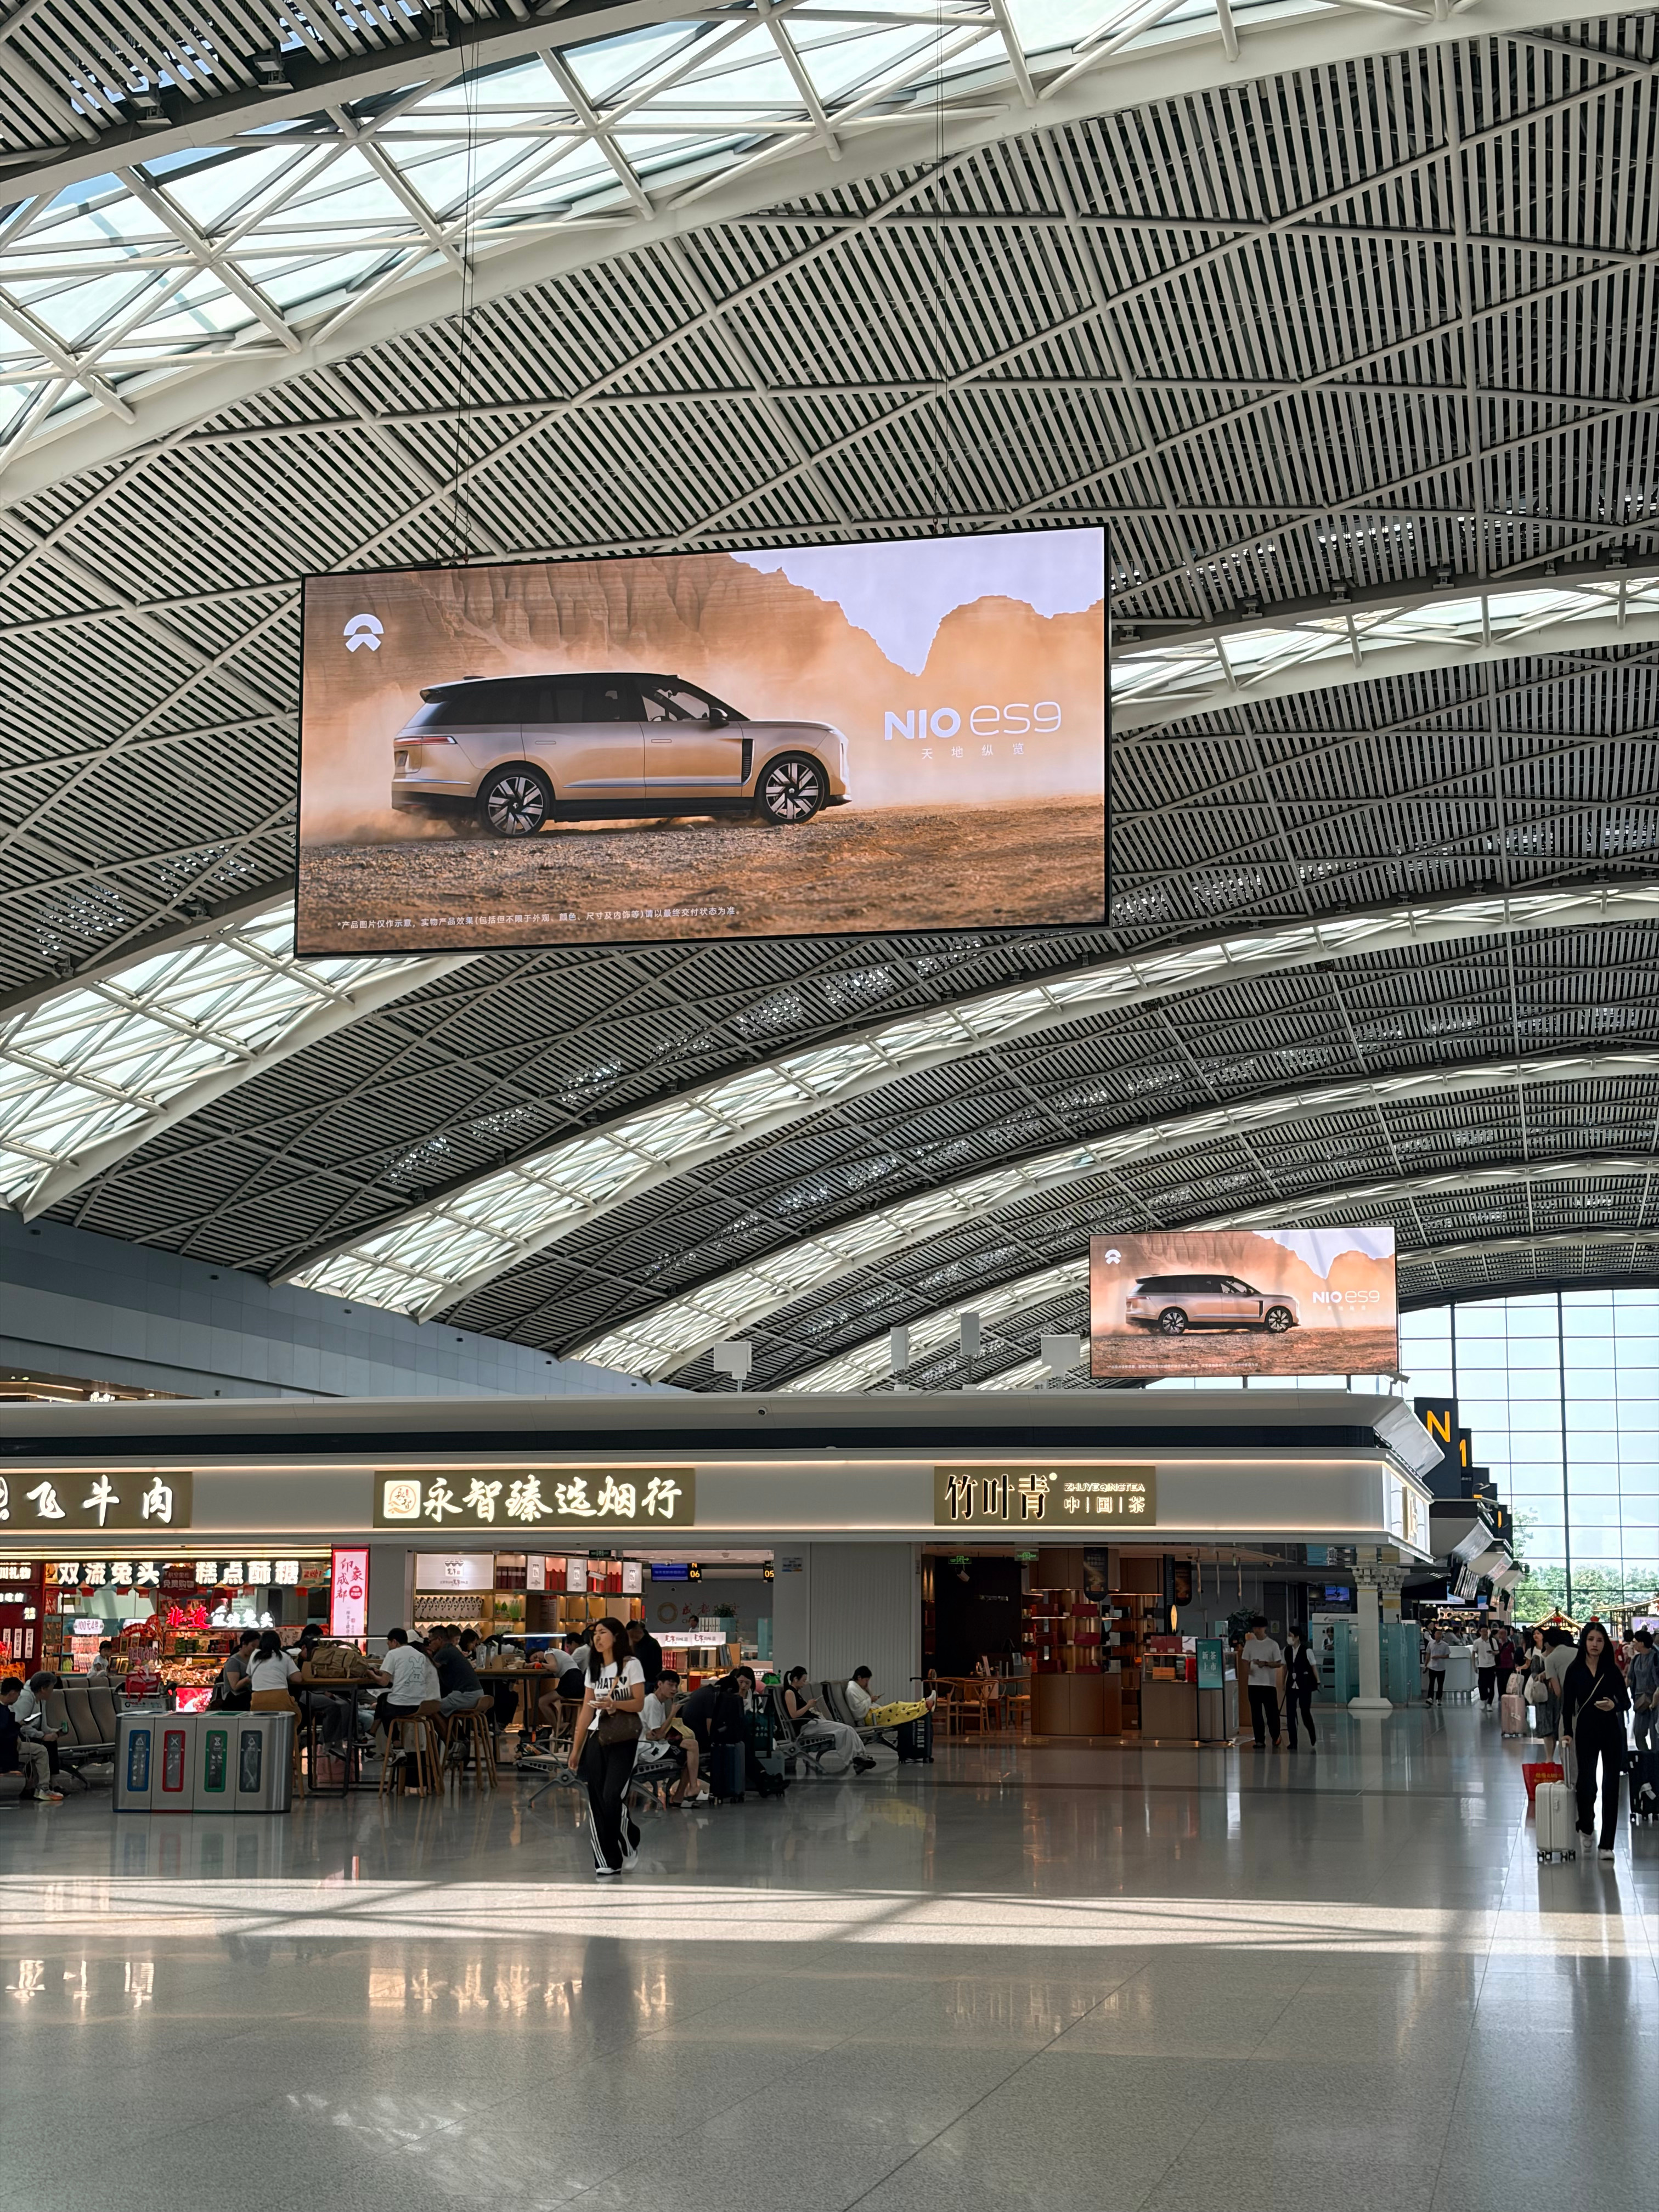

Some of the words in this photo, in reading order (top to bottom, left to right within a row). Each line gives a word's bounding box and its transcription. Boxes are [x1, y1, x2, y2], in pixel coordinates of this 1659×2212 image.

[884, 707, 961, 741] NIO
[921, 742, 1024, 760] 天地纵览
[1312, 1291, 1342, 1304] NIO
[1426, 1410, 1451, 1443] N
[423, 1474, 683, 1523] 永智臻选烟行
[945, 1474, 1050, 1520] 竹叶青
[58, 1562, 160, 1585] 双流兔头
[764, 1570, 774, 1578] 05
